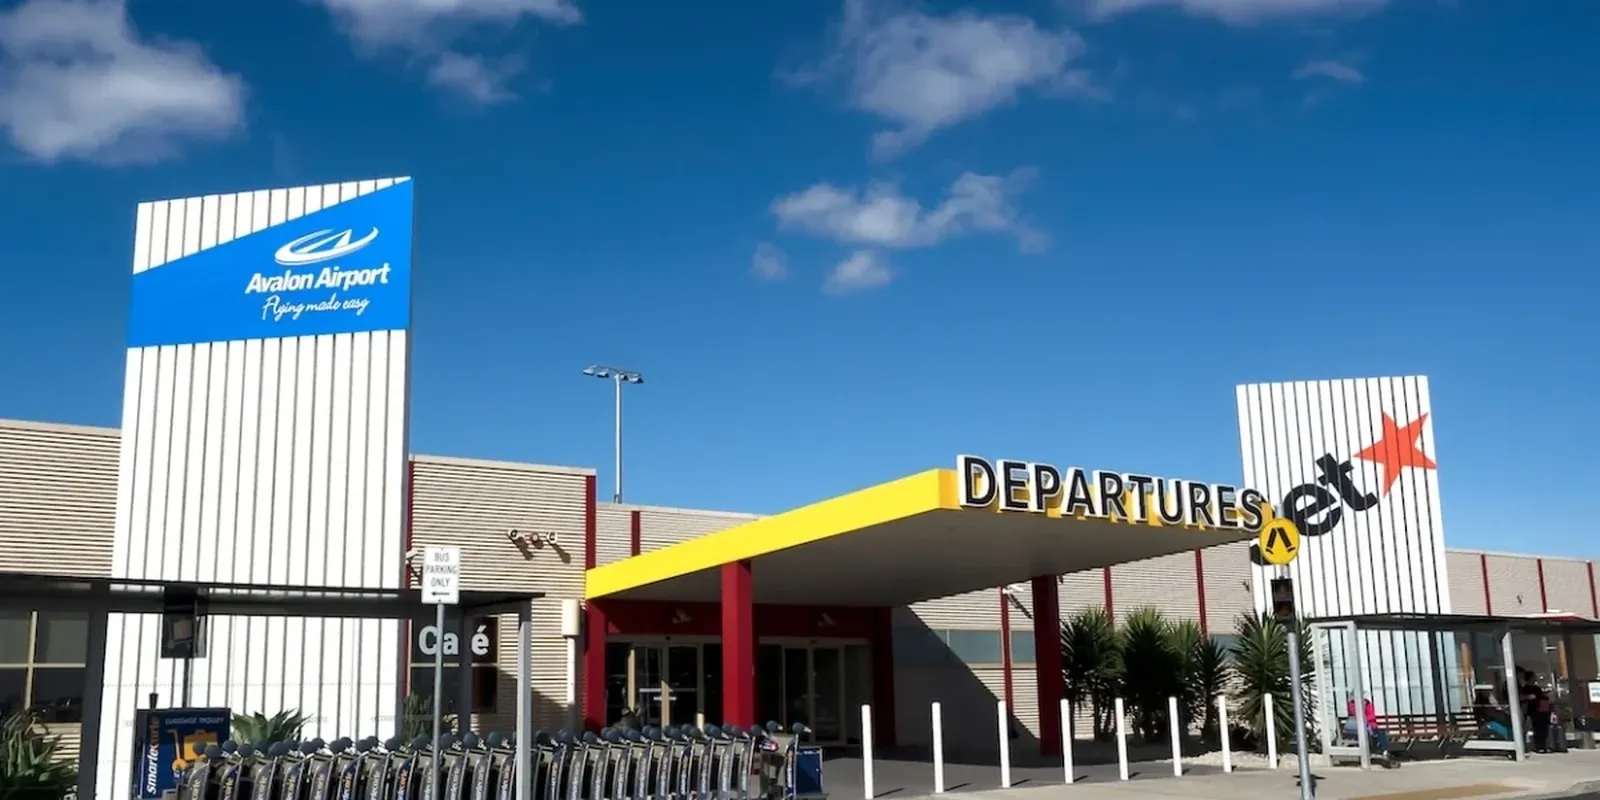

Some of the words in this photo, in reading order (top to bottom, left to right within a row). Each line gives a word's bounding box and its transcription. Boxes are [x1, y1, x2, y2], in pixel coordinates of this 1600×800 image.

[245, 270, 313, 294] Avalon
[314, 262, 391, 291] Airport
[262, 294, 305, 322] Flying
[305, 292, 341, 312] made
[342, 297, 370, 316] easy
[957, 454, 1266, 532] DEPARTURES
[425, 565, 458, 575] PARKING
[434, 552, 450, 562] BUS
[430, 577, 450, 587] ONLY
[418, 624, 490, 655] Caé
